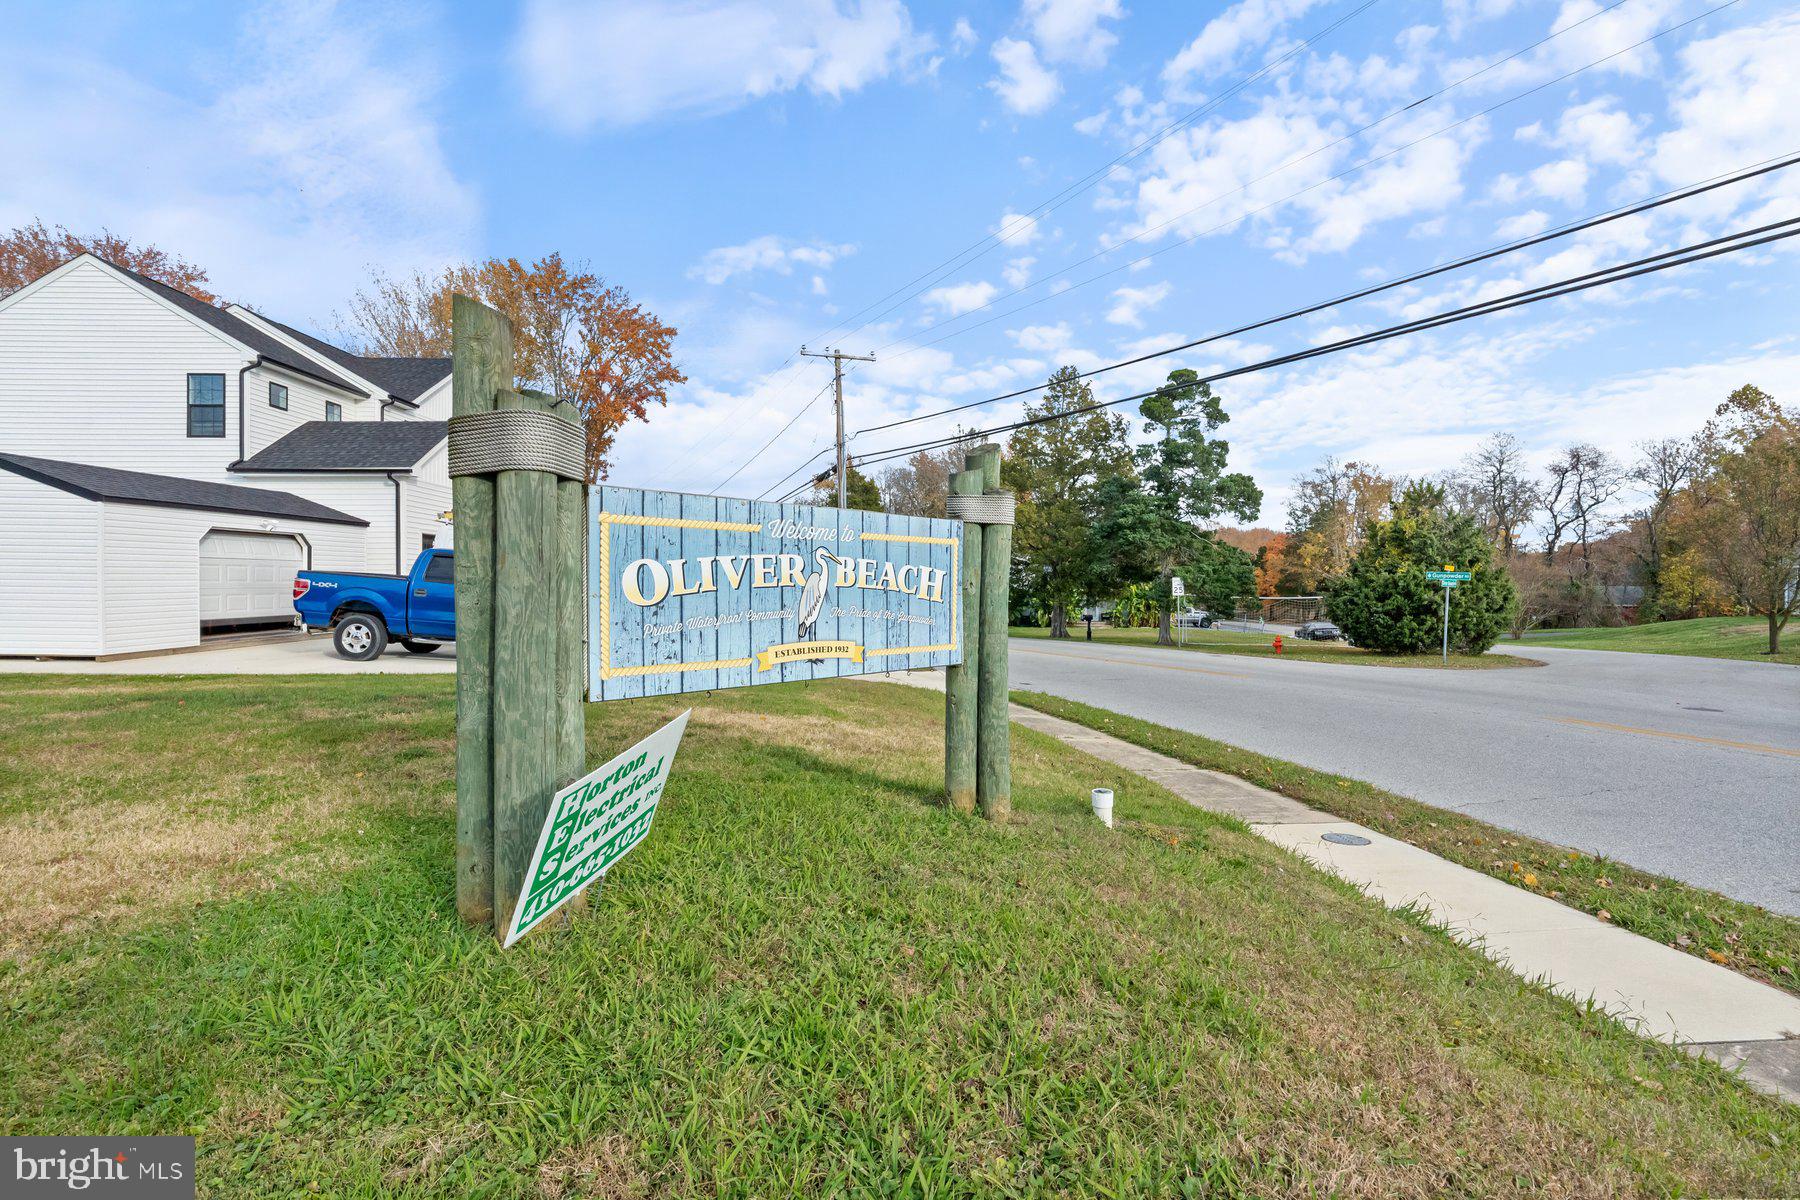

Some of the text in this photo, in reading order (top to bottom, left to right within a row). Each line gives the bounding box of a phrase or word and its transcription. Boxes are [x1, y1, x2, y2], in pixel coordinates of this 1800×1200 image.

[768, 519, 856, 542] Welcome to
[621, 553, 948, 607] OLIVER BEACH
[643, 607, 796, 639] Private Waterfront Community
[830, 606, 846, 618] The
[848, 605, 871, 619] Pride
[872, 608, 884, 620] of
[884, 609, 896, 620] the
[774, 645, 849, 659] ESTABLISHED 1932
[547, 755, 665, 854] Electrical
[556, 750, 648, 824] Horton
[538, 797, 641, 881] Services
[519, 811, 653, 926] 410-665-1032
